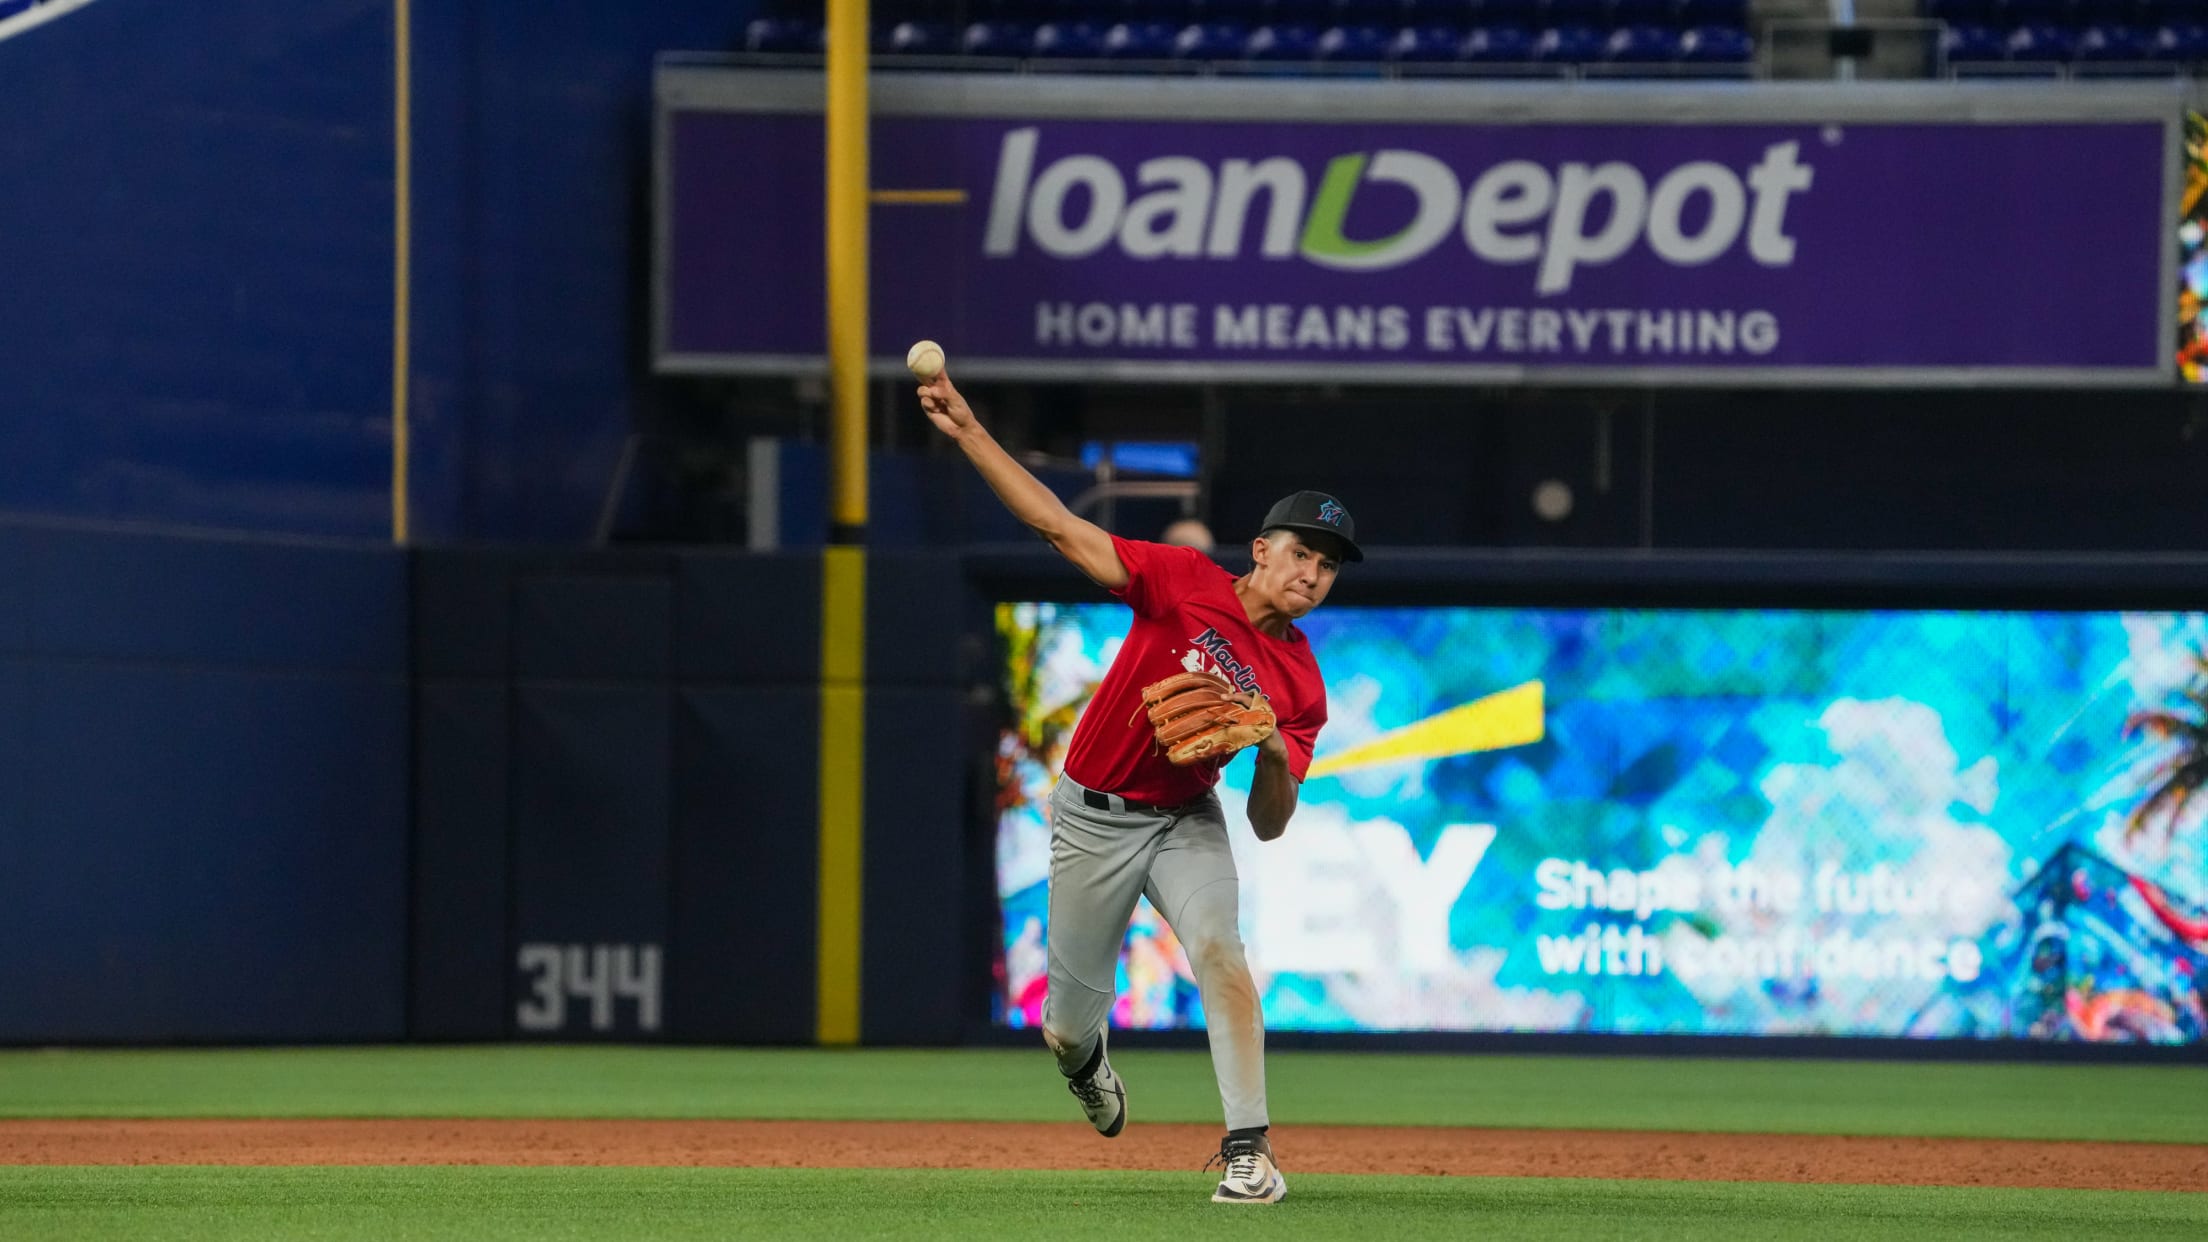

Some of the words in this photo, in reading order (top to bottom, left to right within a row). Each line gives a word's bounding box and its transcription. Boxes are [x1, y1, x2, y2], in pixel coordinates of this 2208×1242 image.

[982, 127, 1813, 294] loanDepot
[1036, 303, 1196, 346] HOME
[1214, 305, 1410, 350] MEANS
[1425, 307, 1780, 353] EVERYTHING
[1189, 627, 1270, 701] Marlin
[1257, 823, 1497, 972] EY
[1535, 858, 1700, 921] Shape
[1714, 861, 1802, 913] the
[1814, 861, 1983, 914] future
[1536, 922, 1663, 976] with
[517, 944, 661, 1030] 344
